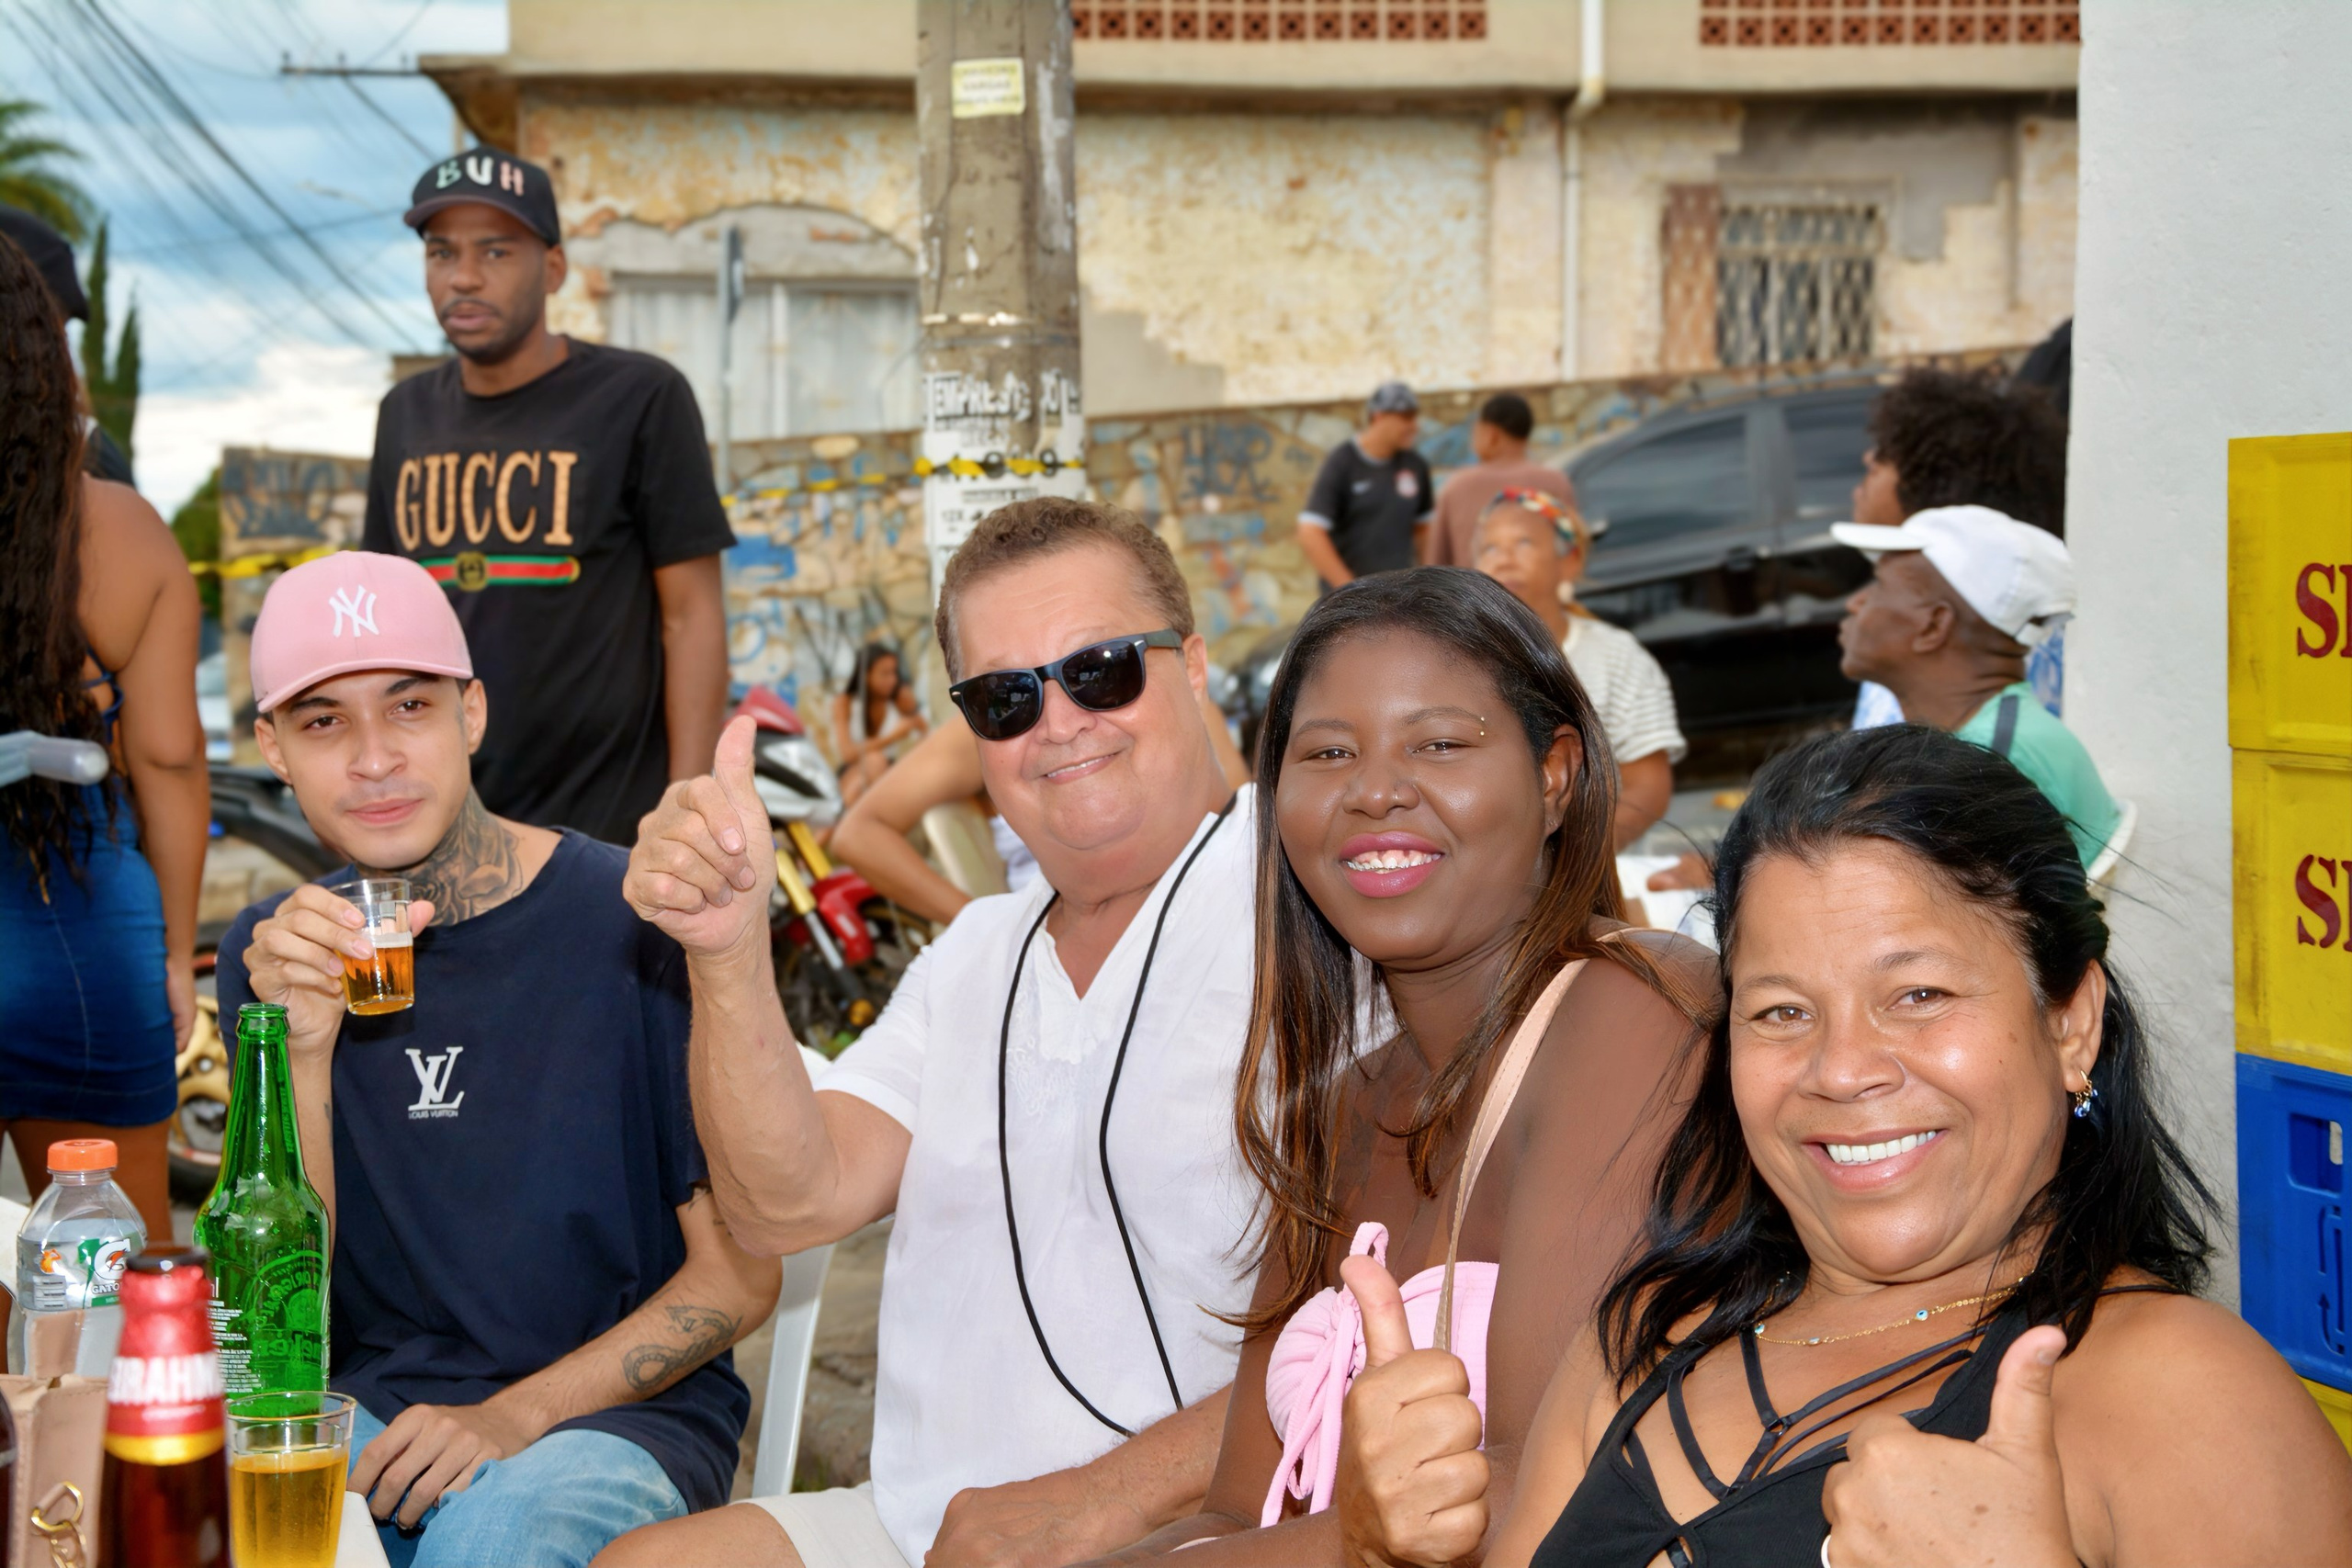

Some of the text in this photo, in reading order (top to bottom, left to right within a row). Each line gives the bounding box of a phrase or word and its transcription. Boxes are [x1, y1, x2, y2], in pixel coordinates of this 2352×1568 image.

[435, 155, 525, 197] BUH
[395, 450, 578, 551] GUCCI
[329, 584, 380, 637] NY
